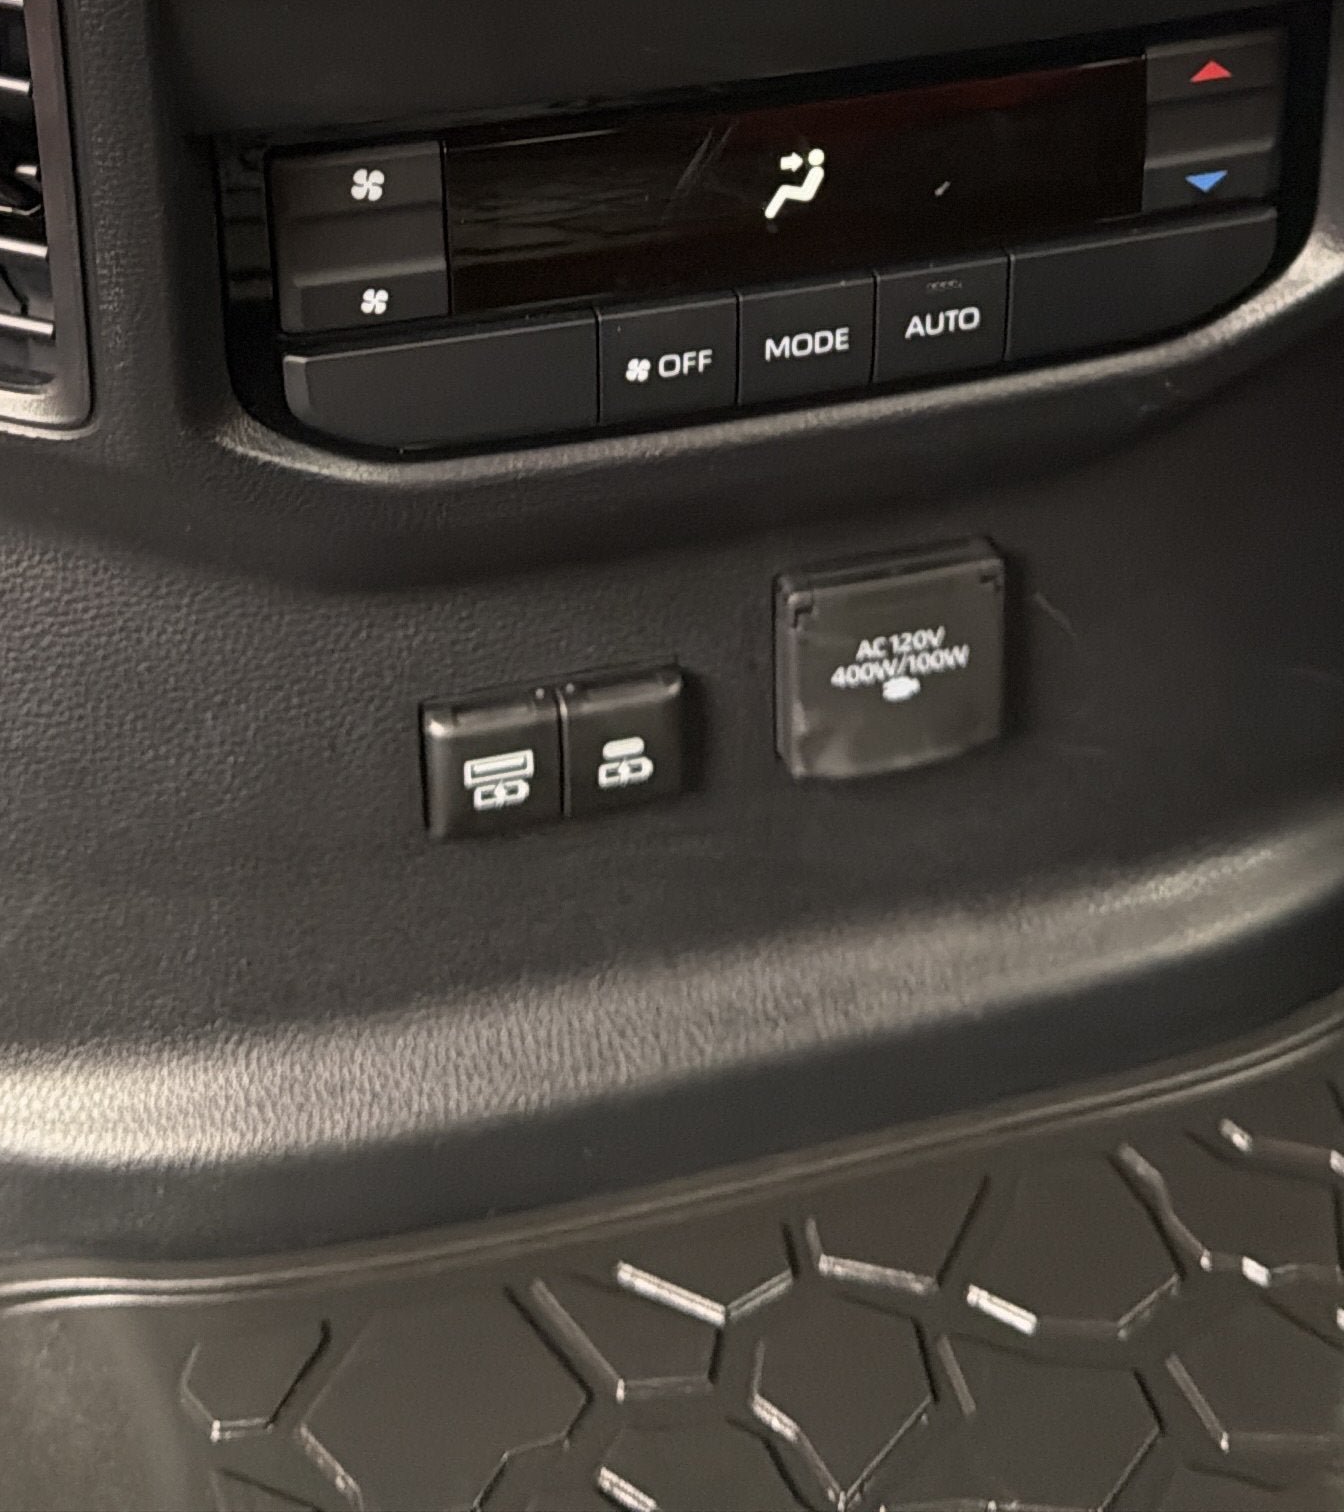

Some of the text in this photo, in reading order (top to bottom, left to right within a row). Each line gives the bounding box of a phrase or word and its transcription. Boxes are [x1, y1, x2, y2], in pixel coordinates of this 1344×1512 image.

[904, 306, 981, 340] AUTO
[764, 327, 850, 362] MODE
[658, 348, 713, 378] OFF
[856, 626, 945, 661] AC 120V
[830, 644, 970, 688] 400W/100W
